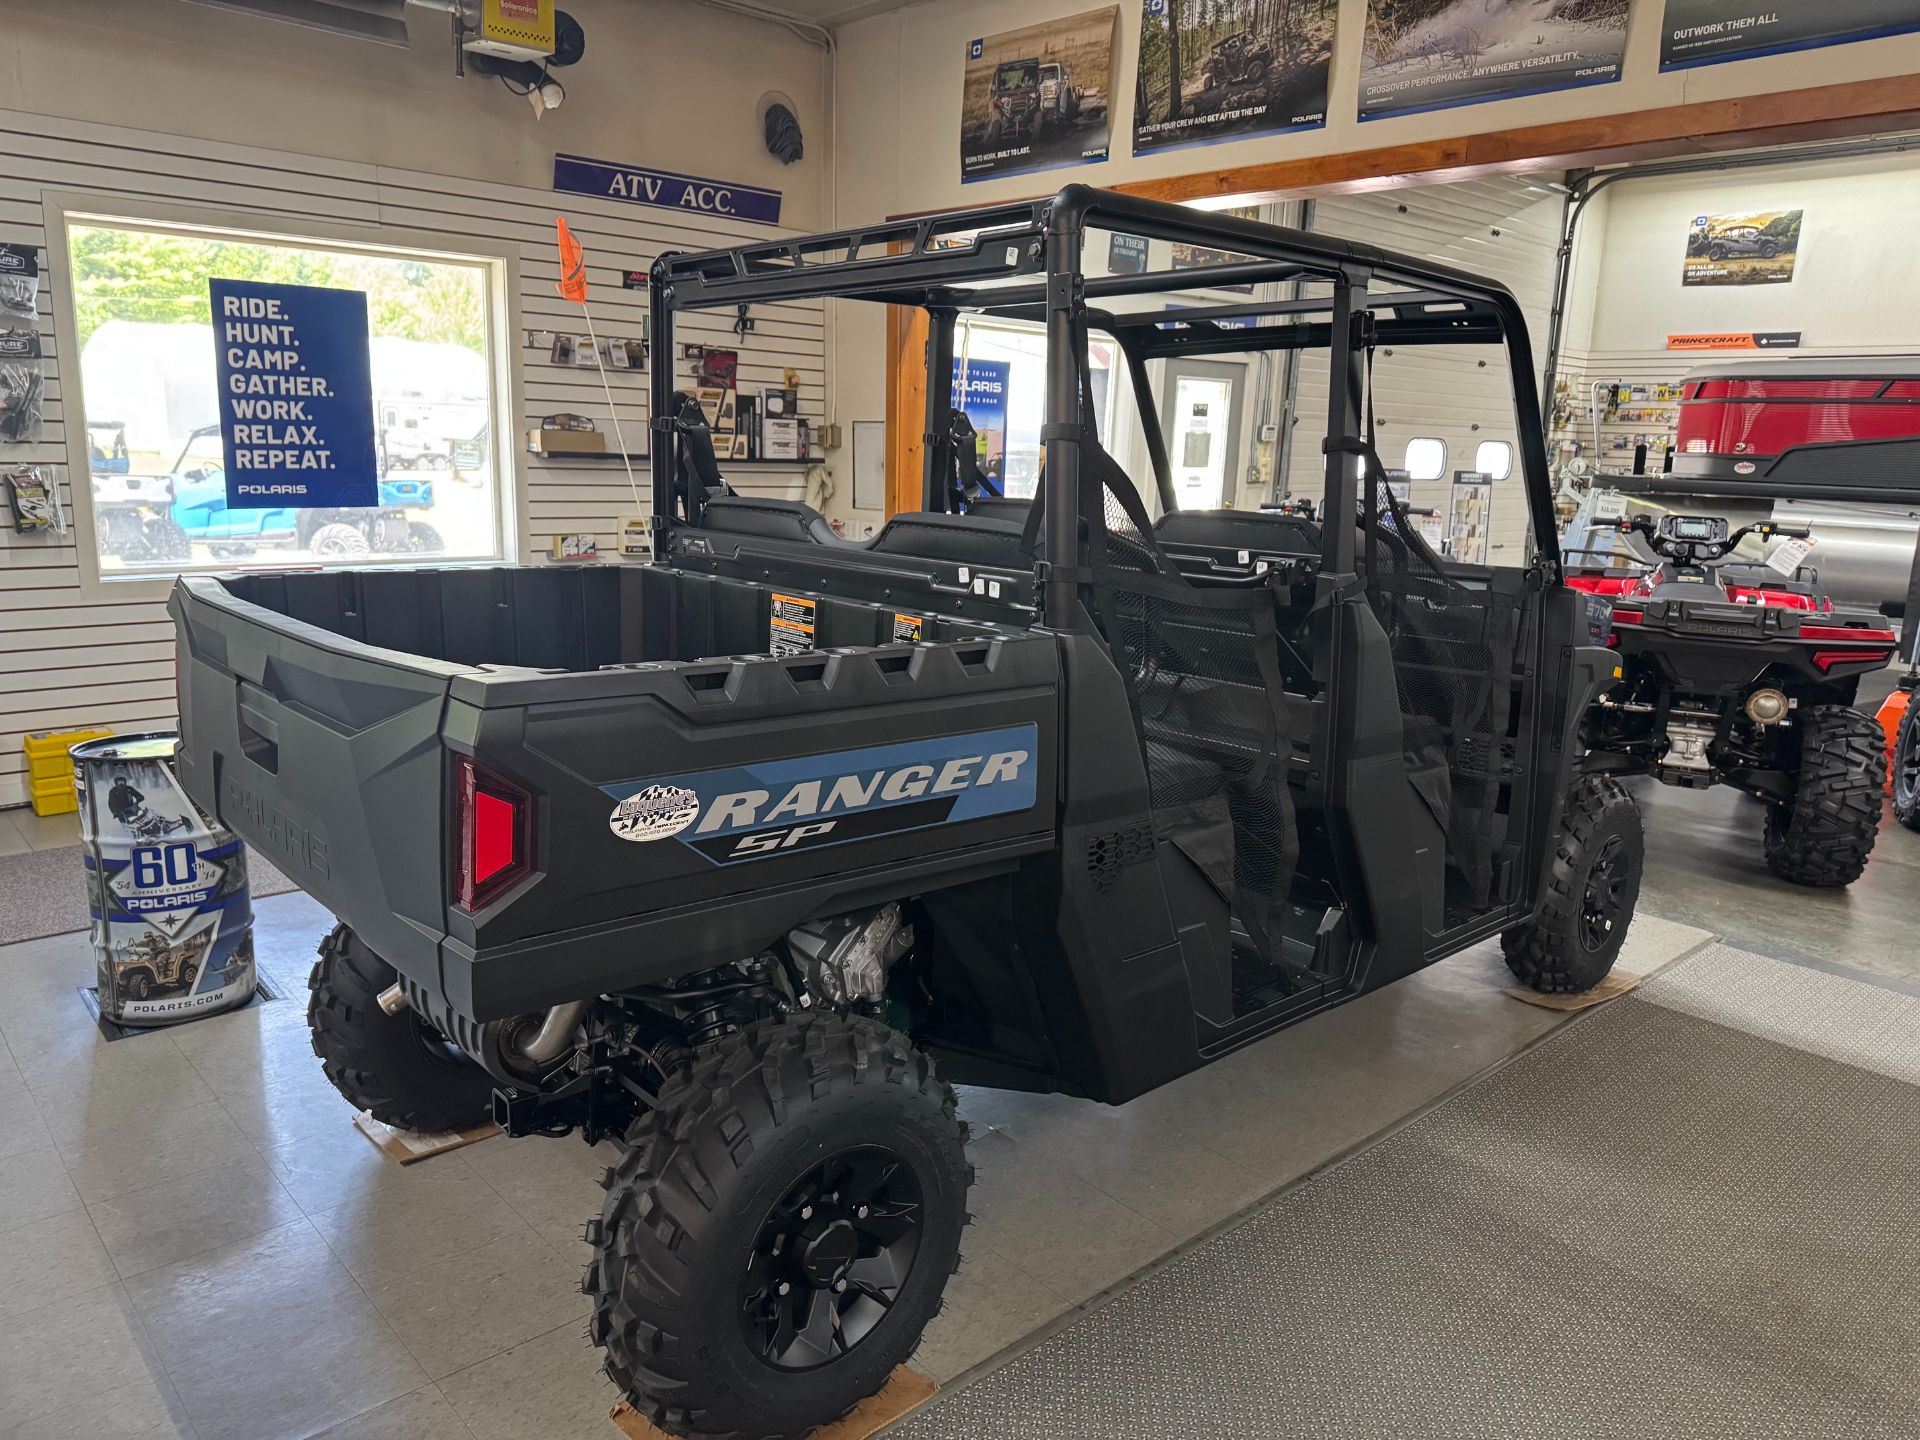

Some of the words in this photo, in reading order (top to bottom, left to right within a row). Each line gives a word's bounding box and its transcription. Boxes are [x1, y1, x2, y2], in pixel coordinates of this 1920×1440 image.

[1673, 22, 1725, 40] OUTWORK
[1726, 16, 1755, 30] THEM
[1757, 12, 1779, 26] ALL
[1366, 81, 1410, 96] CROSSOVER
[1411, 70, 1470, 87] PERFORMANCE.
[1472, 60, 1520, 77] ANYWHERE
[1522, 50, 1580, 68] VERSATILITY.
[1575, 64, 1616, 76] POLARIS
[1138, 123, 1160, 134] GATHER
[1160, 120, 1176, 131] YOUR
[1176, 117, 1194, 128] CREW
[1194, 116, 1207, 126] AND
[1207, 113, 1220, 123] GET
[1220, 110, 1240, 122] AFTER
[1240, 108, 1253, 118] THE
[1254, 105, 1267, 116] DAY
[1292, 113, 1322, 124] POLARIS
[966, 156, 977, 164] BORN
[977, 155, 982, 163] TO
[998, 150, 1010, 158] BUILT
[608, 172, 663, 202] ATV
[680, 184, 736, 215] ACC.
[1114, 235, 1125, 246] ON
[1125, 237, 1145, 250] THEIR
[223, 295, 290, 320] RIDE.
[225, 322, 300, 346] HUNT.
[1671, 336, 1749, 344] PRINCECRAFT
[227, 348, 306, 371] CAMP.
[229, 374, 334, 398] GATHER.
[231, 398, 313, 421] WORK.
[234, 424, 325, 446] RELAX.
[236, 450, 336, 470] REPEAT.
[238, 484, 307, 494] POLARIS
[1687, 624, 1753, 635] POLARIS
[694, 749, 1028, 834] RANGER
[728, 820, 838, 858] SP
[132, 842, 198, 888] 60
[203, 870, 216, 880] '14
[115, 880, 131, 890] '54
[132, 882, 203, 896] ANNIVERSARY
[127, 891, 207, 910] POLARIS
[134, 992, 224, 1014] POLARIS.COM
